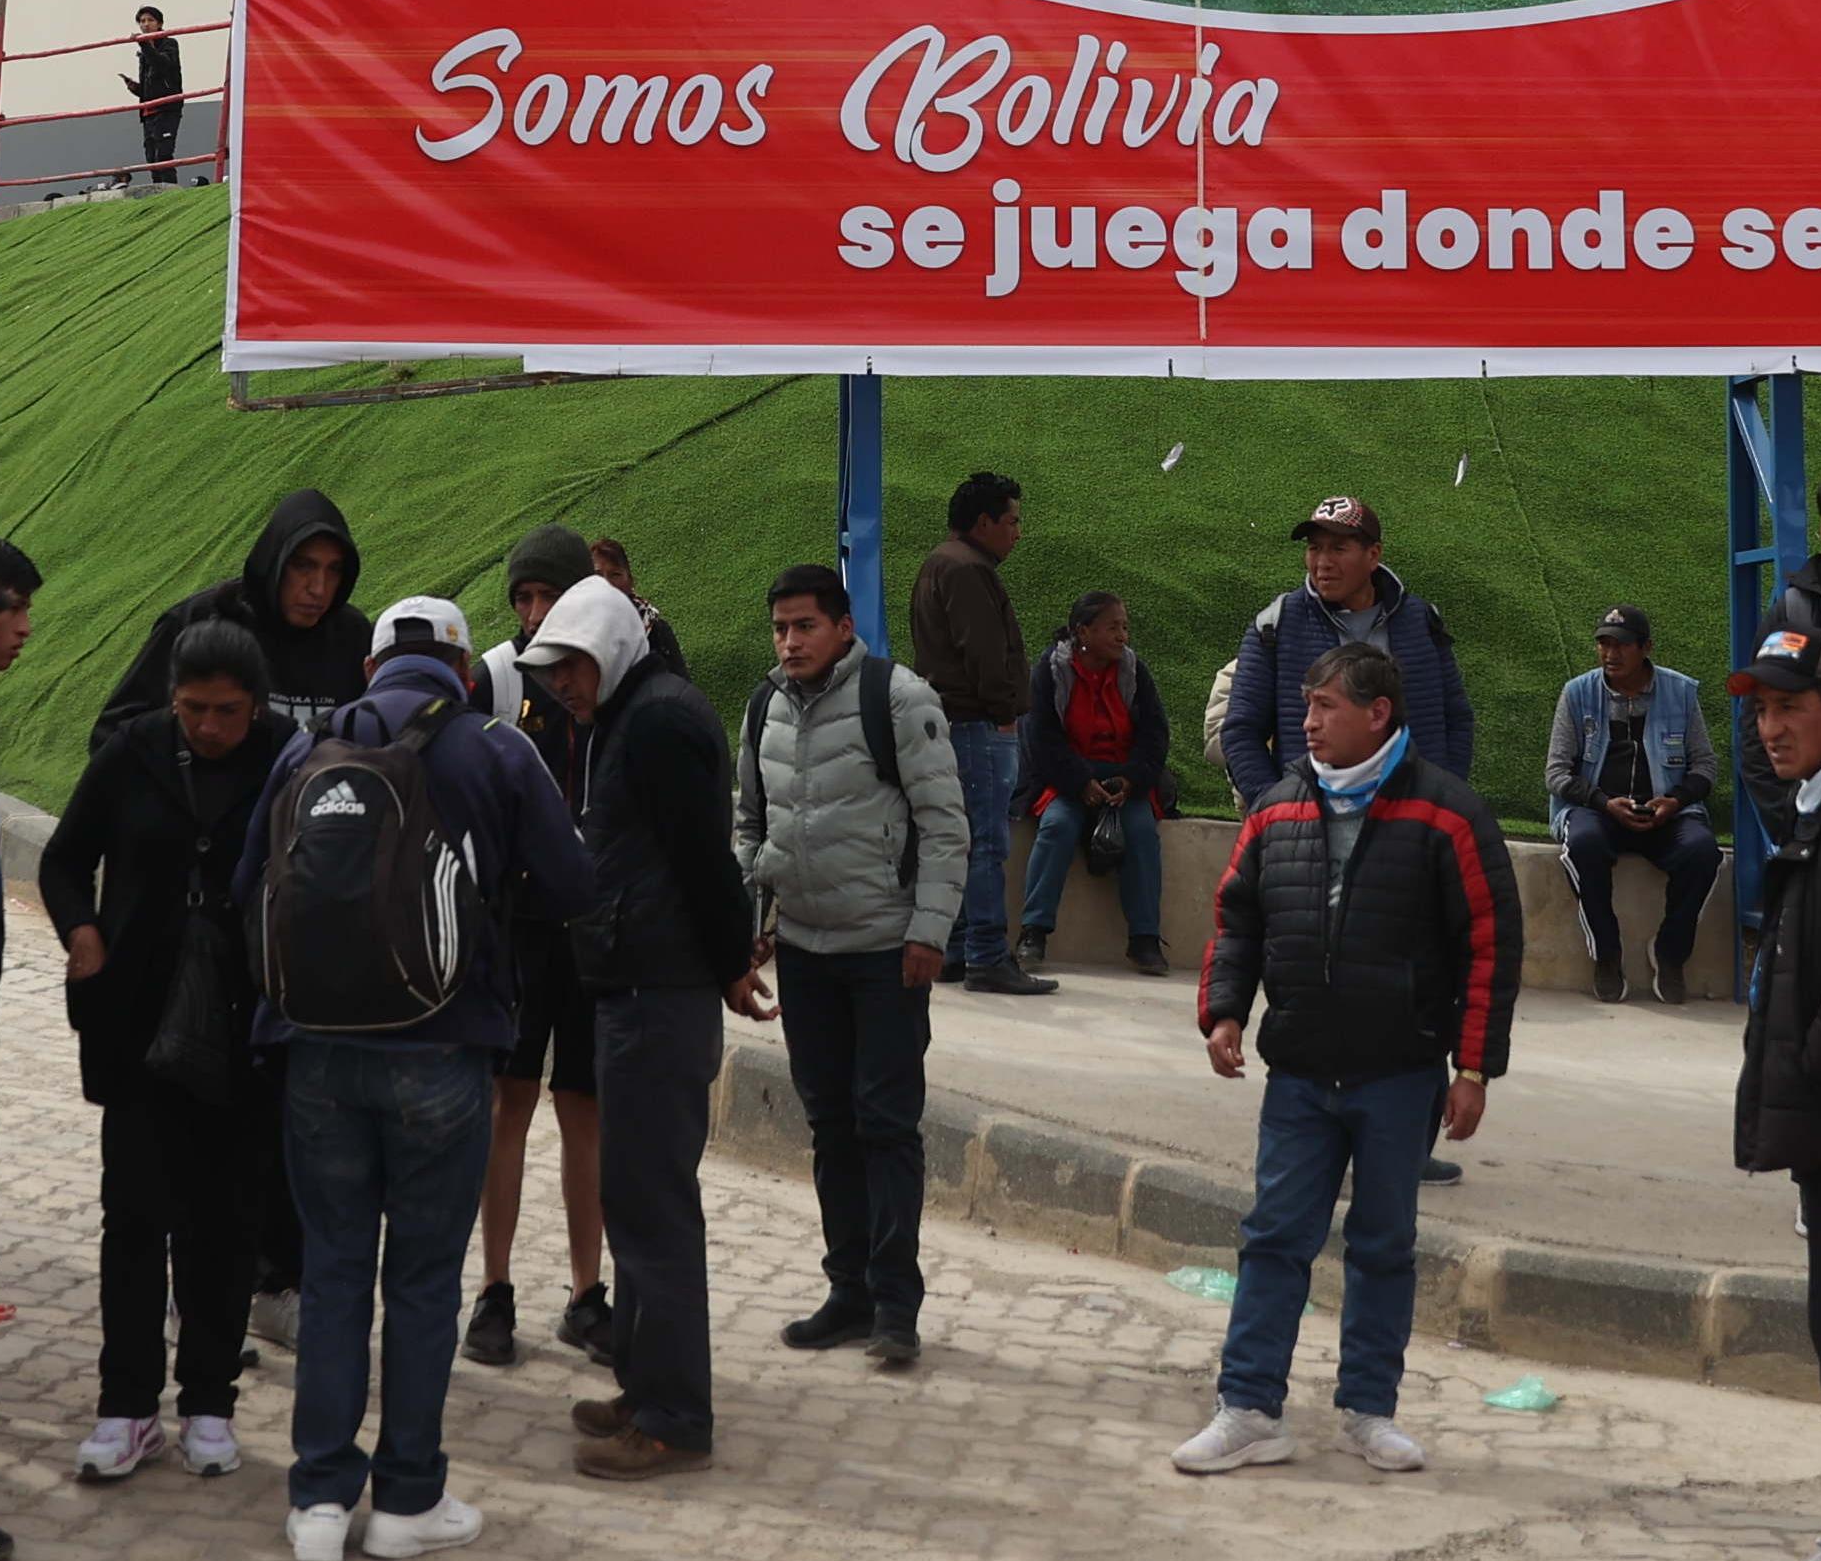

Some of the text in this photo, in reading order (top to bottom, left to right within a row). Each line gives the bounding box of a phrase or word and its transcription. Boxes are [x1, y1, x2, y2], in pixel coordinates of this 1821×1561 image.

[415, 24, 1279, 173] Somos Bolivia
[837, 204, 966, 270] se
[986, 179, 1313, 298] juega
[1341, 189, 1695, 271] donde
[310, 800, 366, 816] adidas
